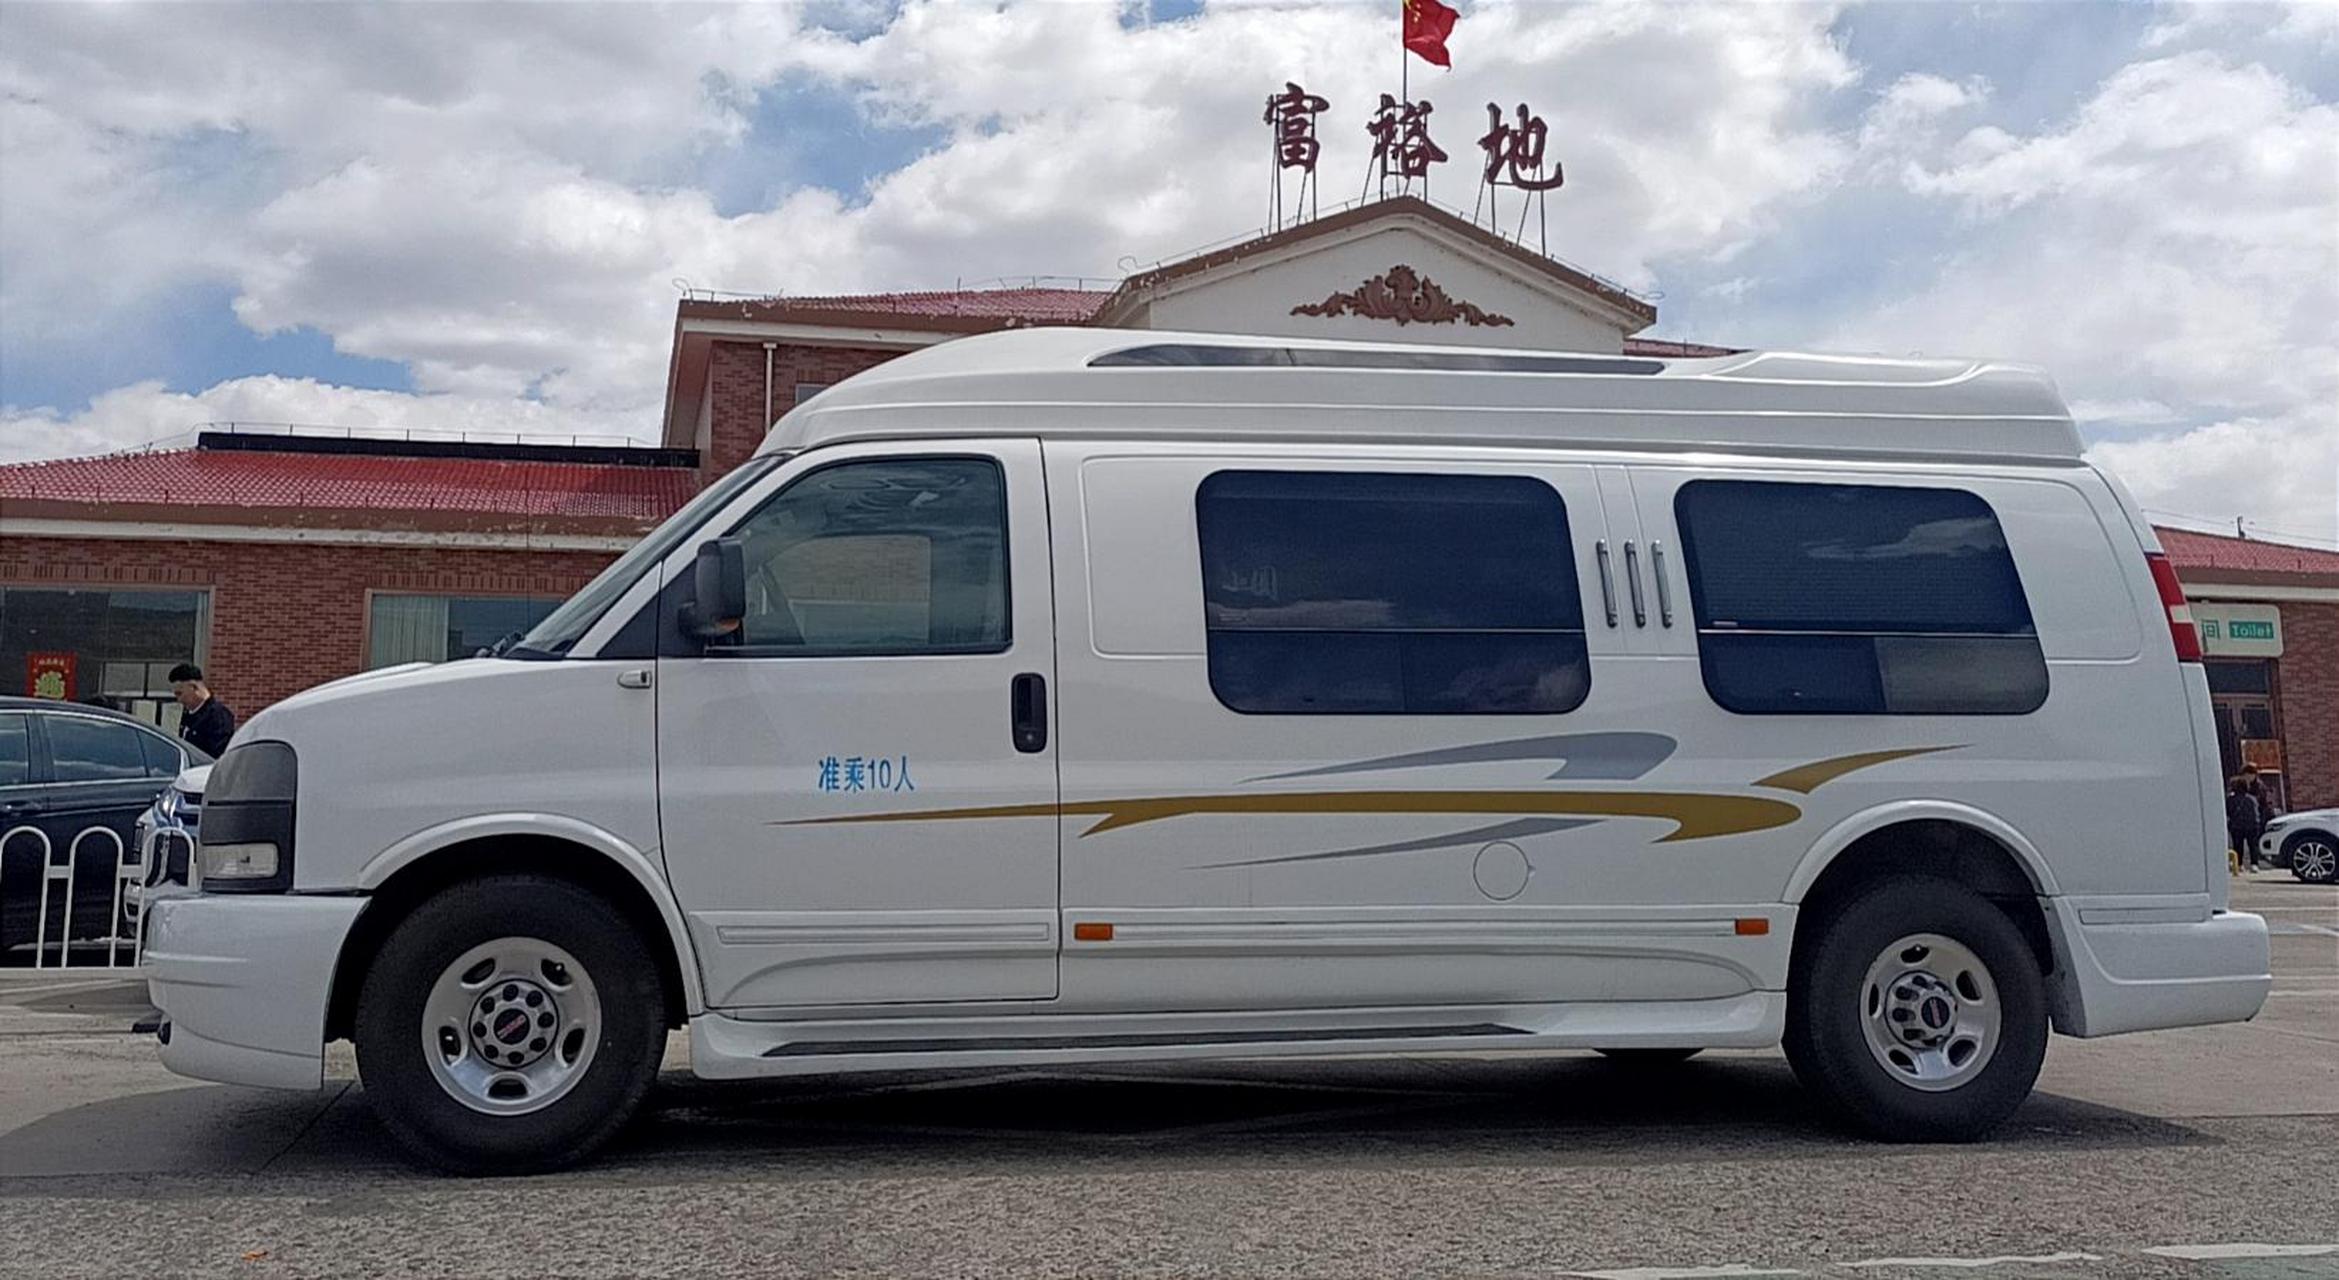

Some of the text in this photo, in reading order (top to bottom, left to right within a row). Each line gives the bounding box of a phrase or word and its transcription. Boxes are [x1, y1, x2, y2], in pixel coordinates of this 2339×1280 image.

[1263, 81, 1563, 191] 富裕地
[2231, 622, 2272, 638] Toilet
[818, 755, 915, 793] 准乘10人
